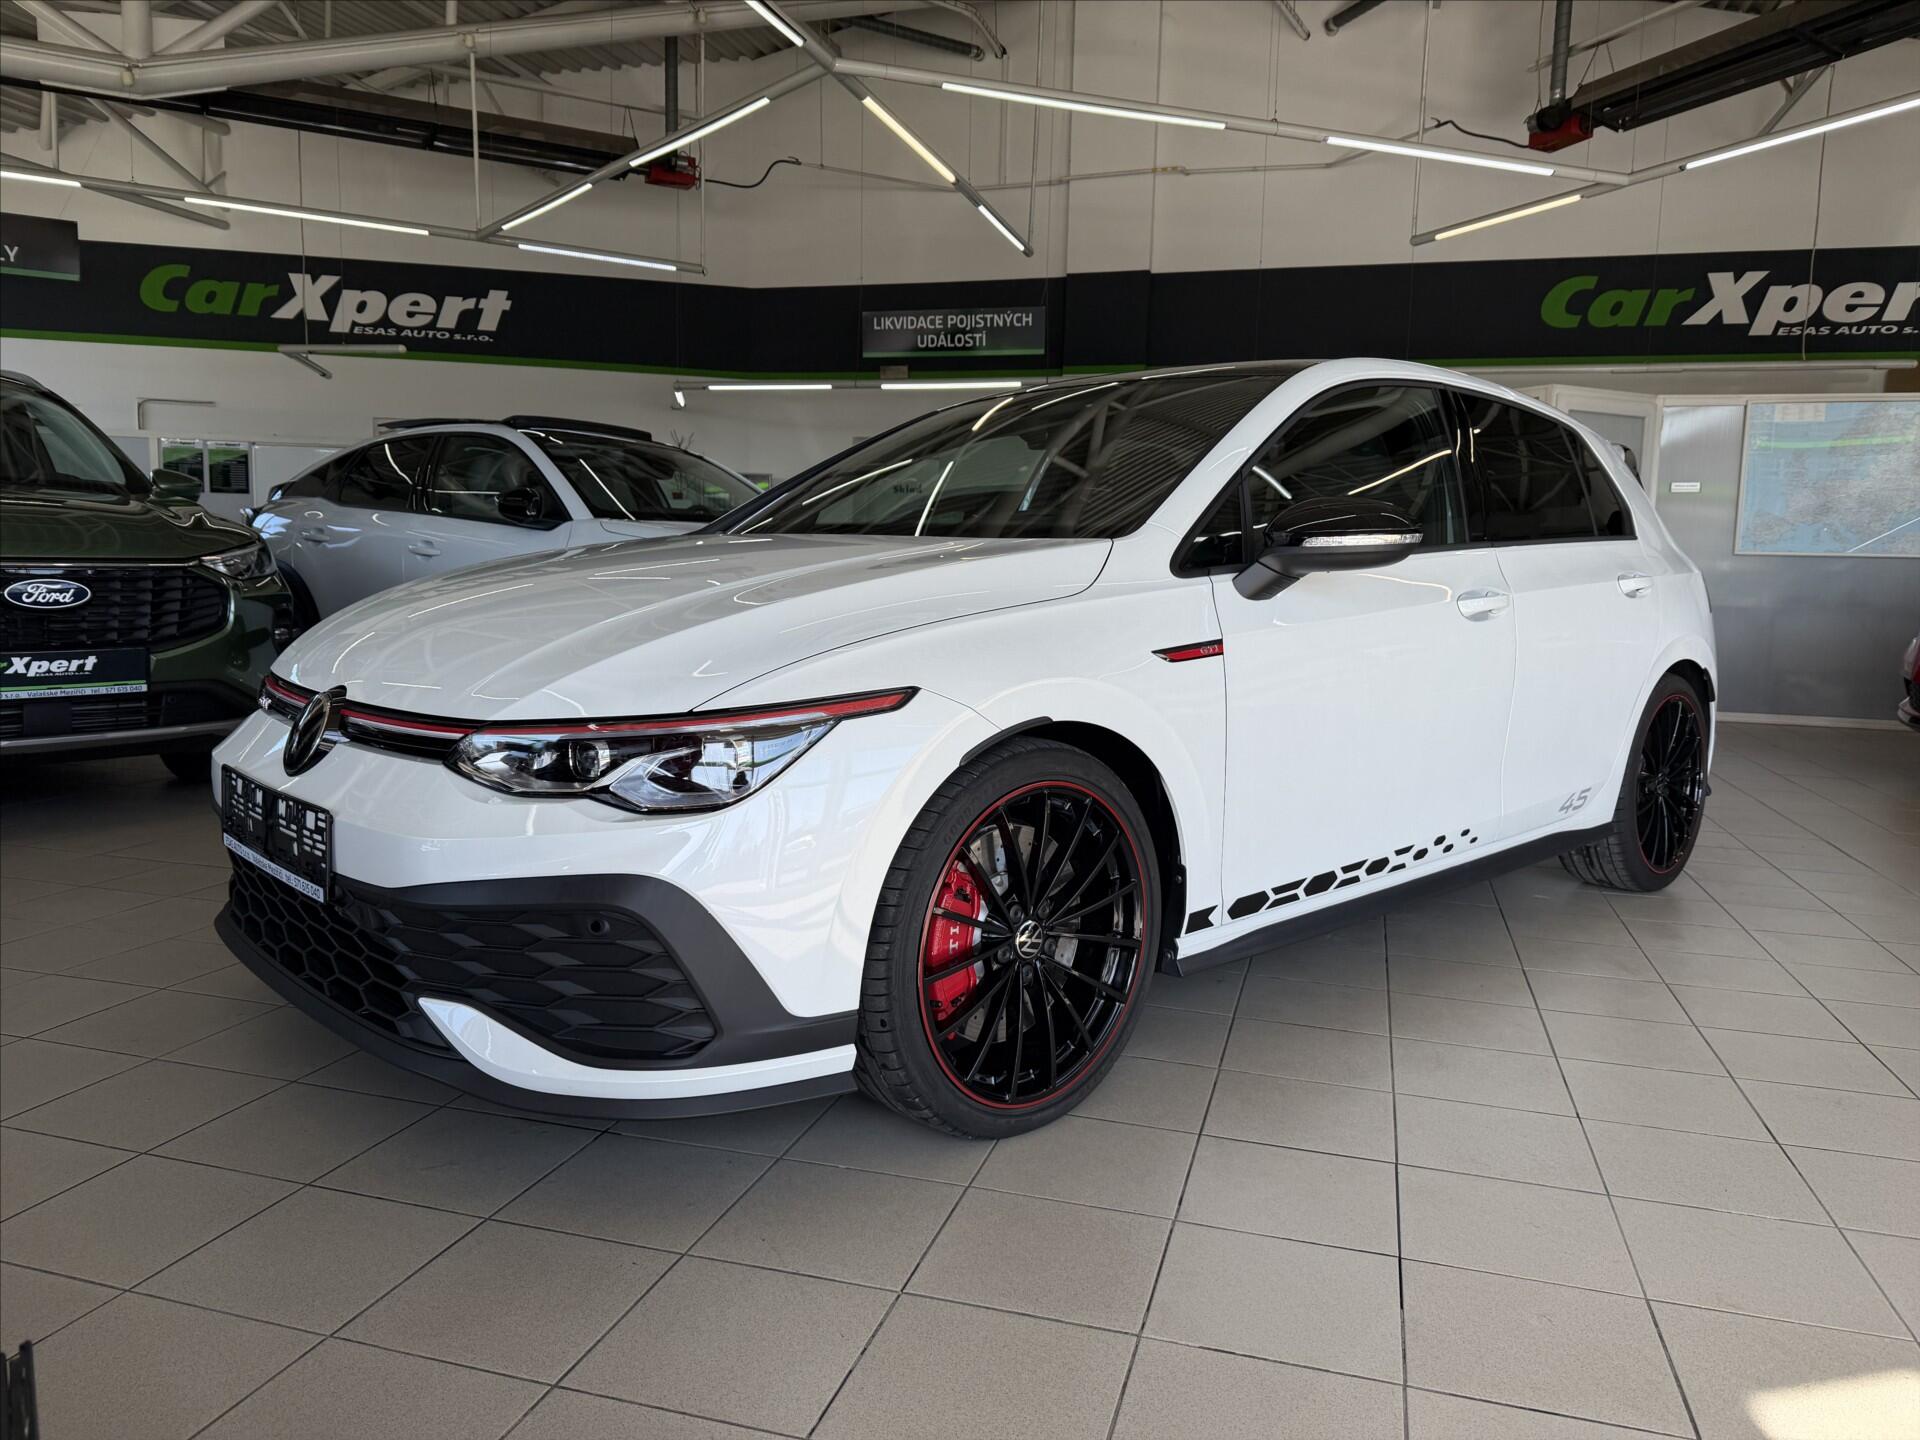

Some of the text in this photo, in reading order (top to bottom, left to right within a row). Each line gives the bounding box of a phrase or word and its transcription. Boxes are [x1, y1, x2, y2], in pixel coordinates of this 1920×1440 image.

[0, 245, 19, 262] Y
[139, 263, 512, 334] CarXpert
[873, 311, 1032, 331] LIKVIDACE POJISTNÝCH
[1777, 326, 1832, 336] ESAS
[1834, 325, 1899, 335] AUTO
[353, 326, 494, 342] ESAS AUTO s.r.o.
[917, 330, 986, 348] UDÁLOSTÍ
[22, 583, 75, 603] Ford
[1558, 787, 1592, 814] 45
